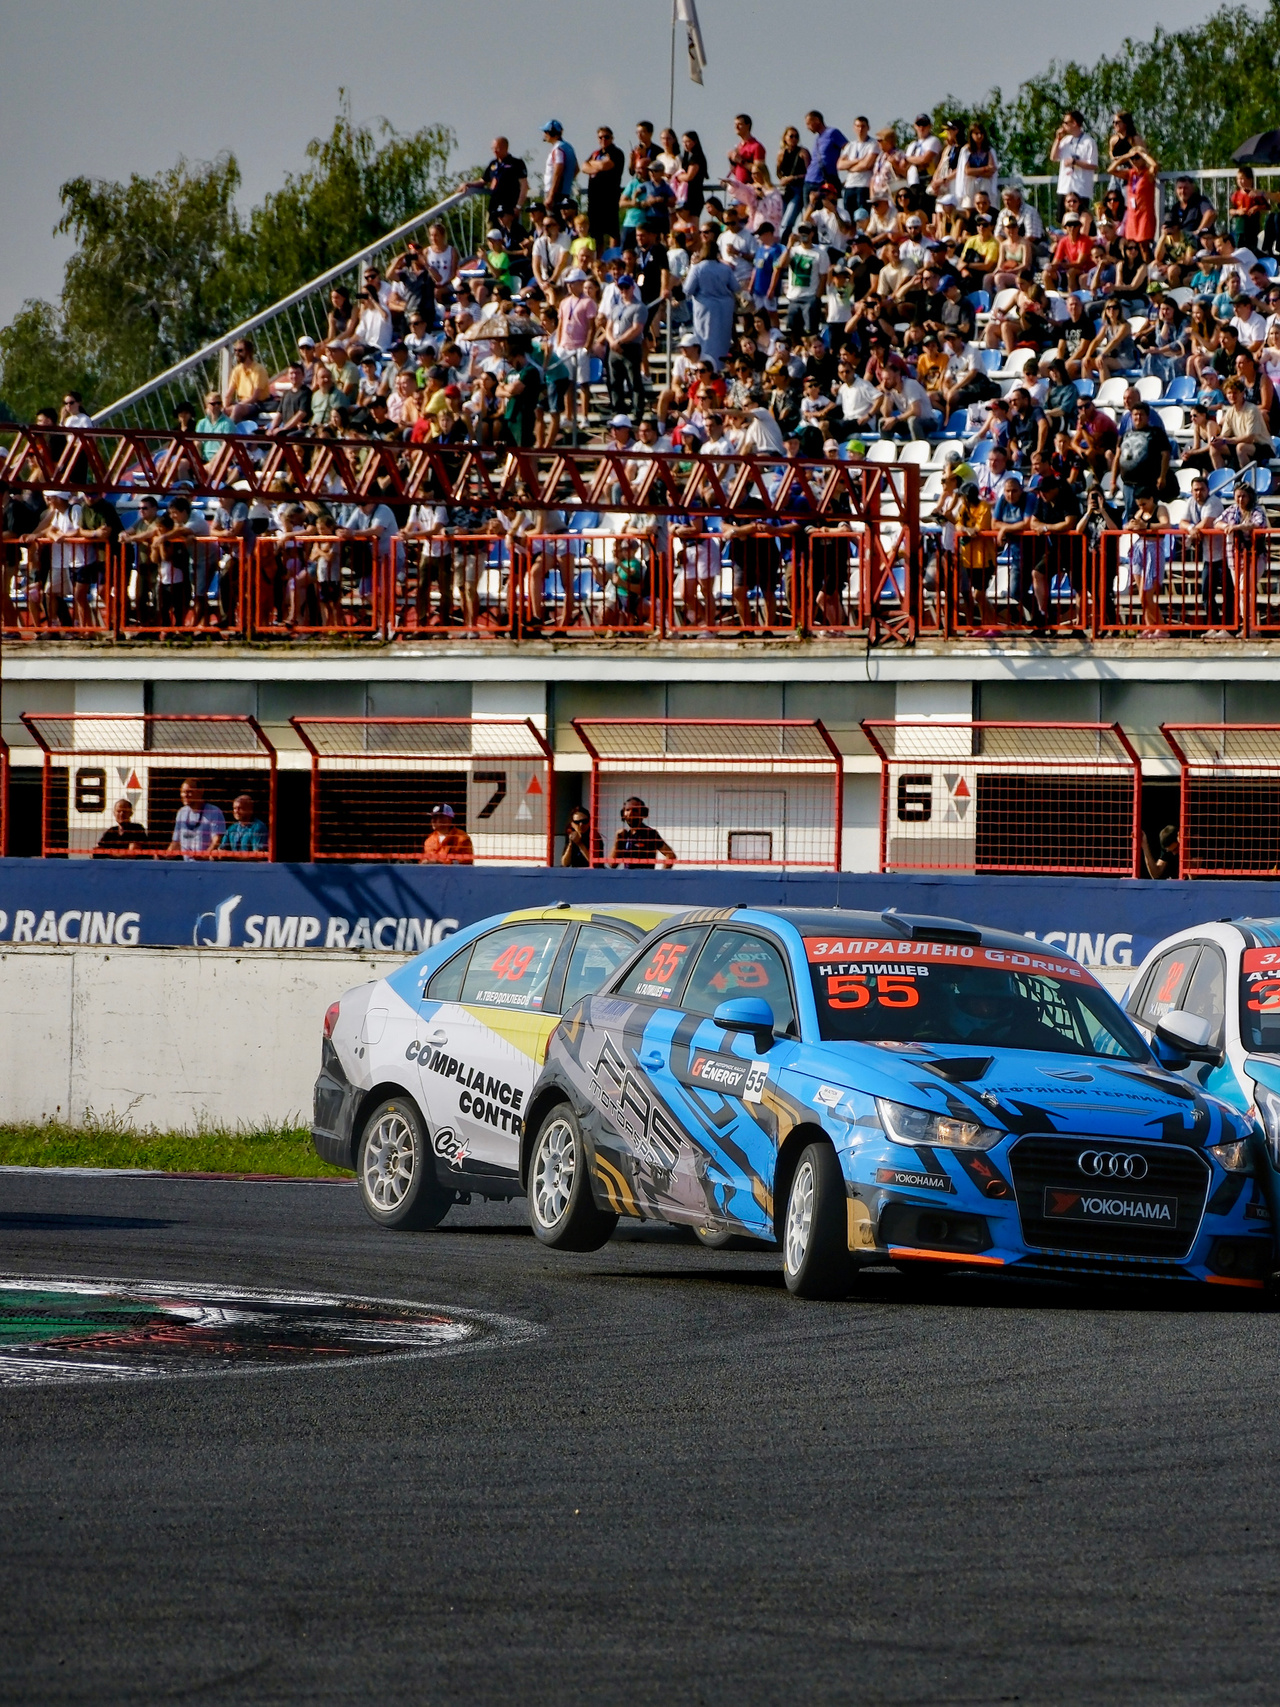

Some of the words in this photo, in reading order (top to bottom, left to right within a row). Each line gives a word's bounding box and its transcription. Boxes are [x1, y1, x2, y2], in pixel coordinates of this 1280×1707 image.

[75, 767, 107, 813] 8
[473, 771, 506, 818] 7
[898, 773, 932, 822] 6
[13, 910, 140, 945] RACING
[243, 914, 321, 949] SMP
[325, 916, 459, 951] RACING
[491, 945, 534, 981] 49
[644, 942, 687, 983] 55
[813, 941, 973, 959] ЗАПРАВЛЕНО
[819, 964, 929, 977] Н.ГАЛИШЕВ
[827, 975, 920, 1010] 55
[405, 1039, 524, 1112] COMPLIANCE
[745, 1069, 767, 1093] 55
[459, 1090, 524, 1138] CONTR
[894, 1172, 945, 1188] YOKOHAMA
[1080, 1196, 1170, 1221] YOKOHAMA
